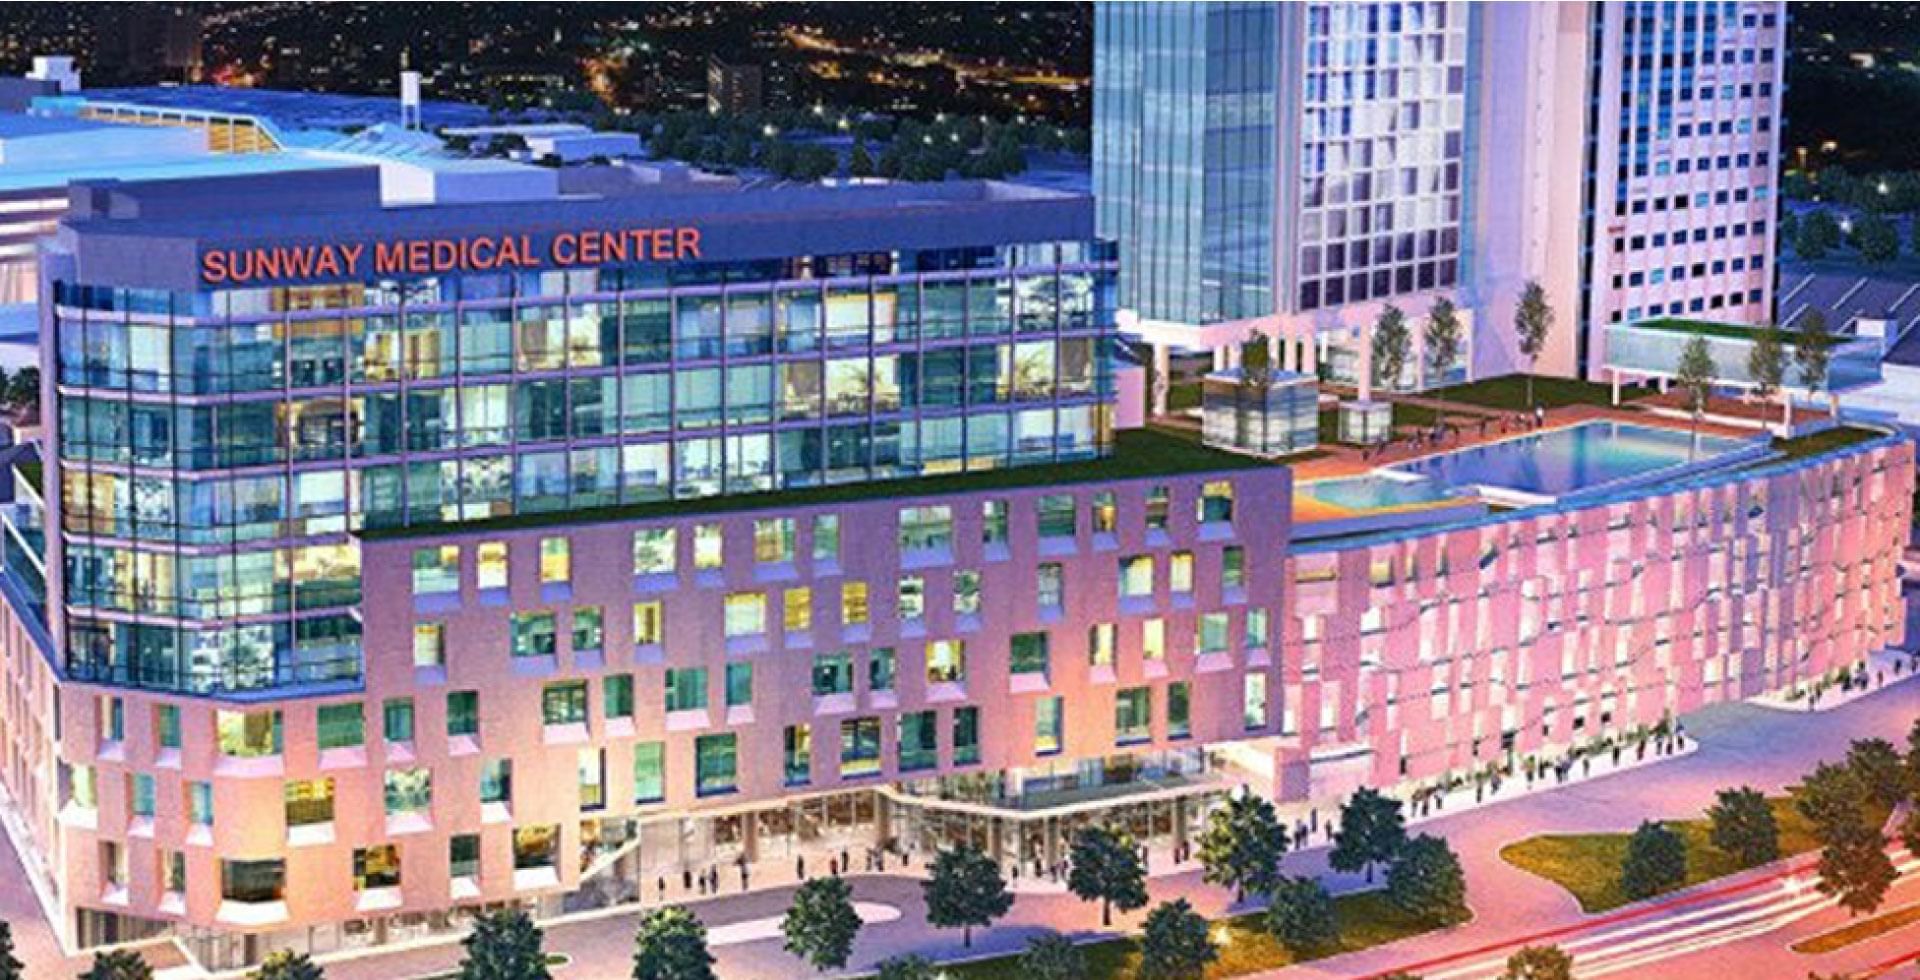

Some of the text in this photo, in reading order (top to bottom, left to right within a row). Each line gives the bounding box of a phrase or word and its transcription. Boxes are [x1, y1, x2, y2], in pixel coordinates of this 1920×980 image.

[203, 228, 702, 281] SUNWAY MEDICAL CENTER
